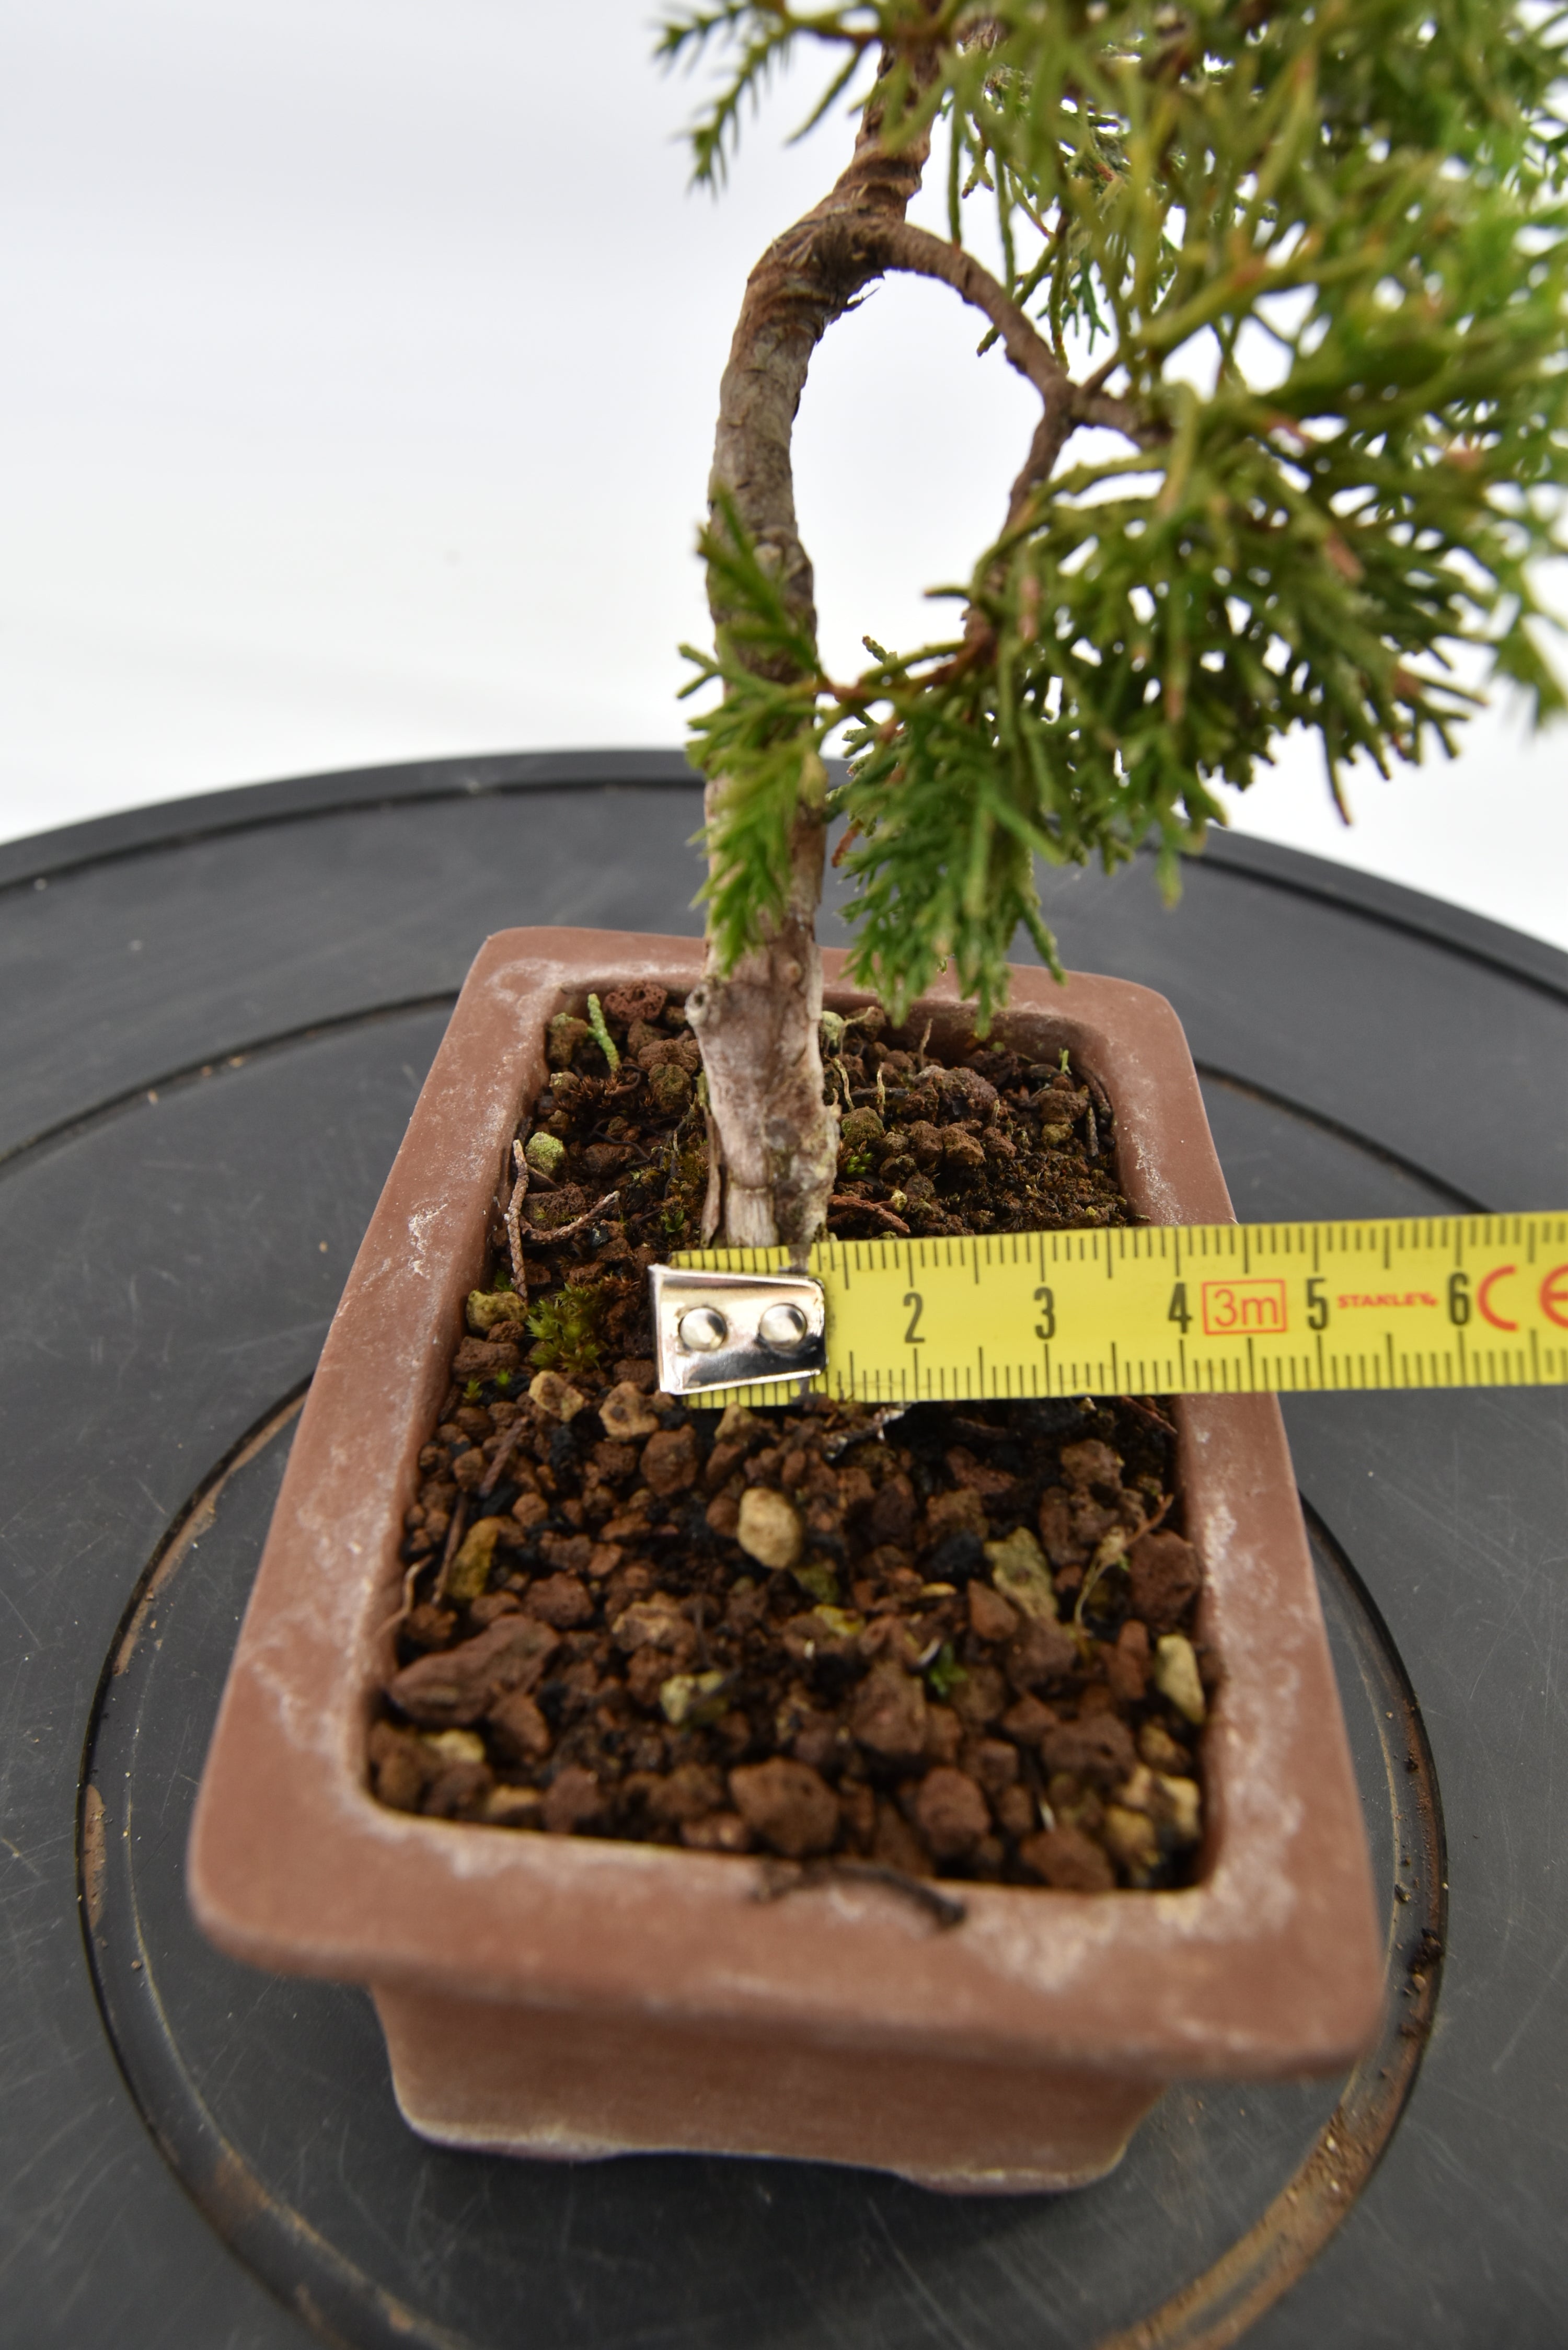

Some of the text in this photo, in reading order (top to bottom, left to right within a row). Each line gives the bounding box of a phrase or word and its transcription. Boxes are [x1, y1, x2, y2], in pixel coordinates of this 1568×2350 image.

[903, 1292, 925, 1343] 2
[1033, 1287, 1055, 1340] 3
[1168, 1282, 1192, 1333] 4
[1214, 1288, 1278, 1327] 3m
[1306, 1277, 1329, 1330] 5
[1448, 1272, 1471, 1326] 6
